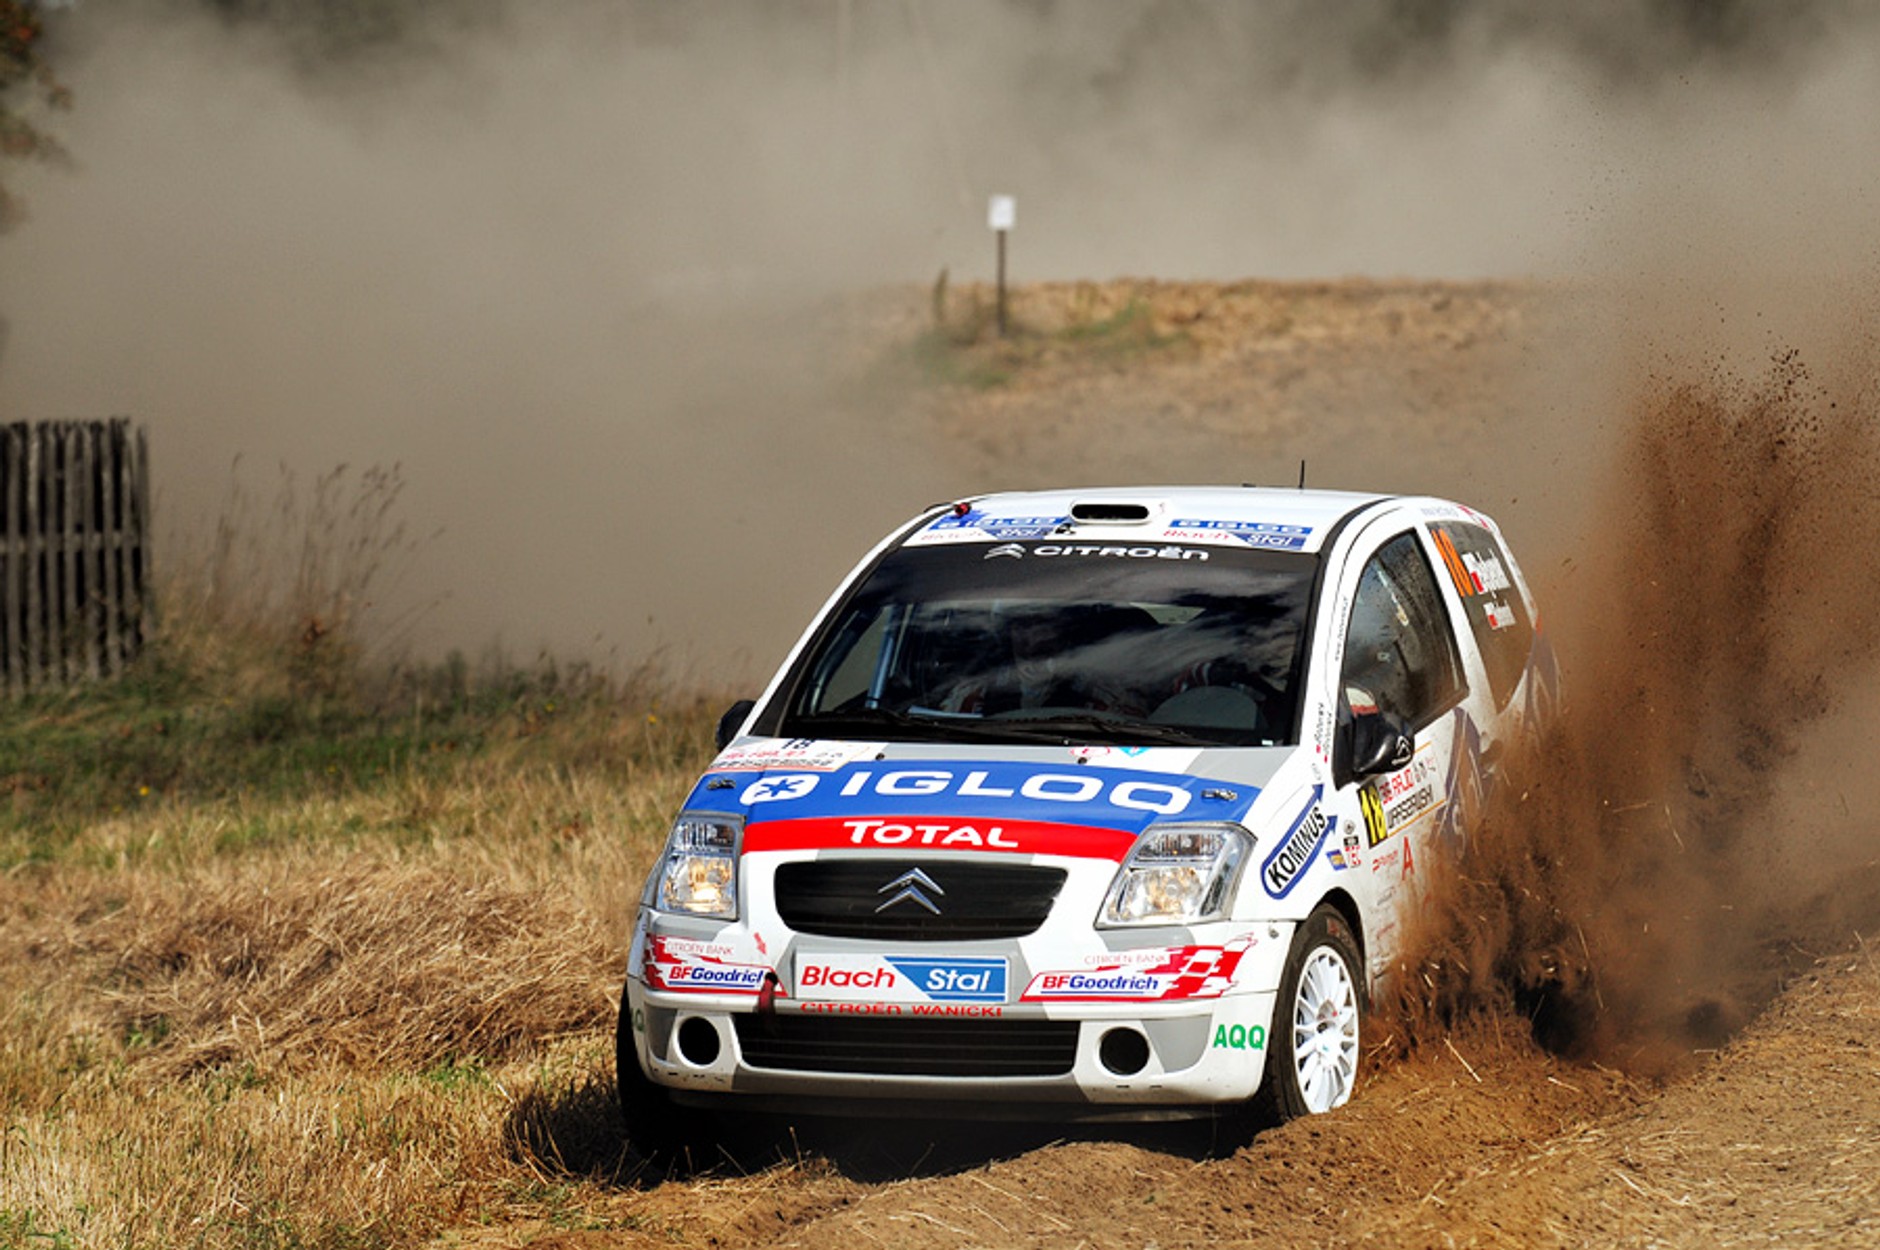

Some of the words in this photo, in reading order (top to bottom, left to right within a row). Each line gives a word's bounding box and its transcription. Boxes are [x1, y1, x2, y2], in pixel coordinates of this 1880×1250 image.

[1361, 785, 1388, 845] 18
[843, 820, 1019, 848] TOTAL
[1268, 806, 1326, 889] KOMINUS
[801, 966, 896, 988] Blach
[926, 968, 991, 992] Stal
[1042, 975, 1159, 990] BFGoodrich
[912, 1004, 1003, 1018] WANICKI
[1213, 1024, 1266, 1050] AQQ
